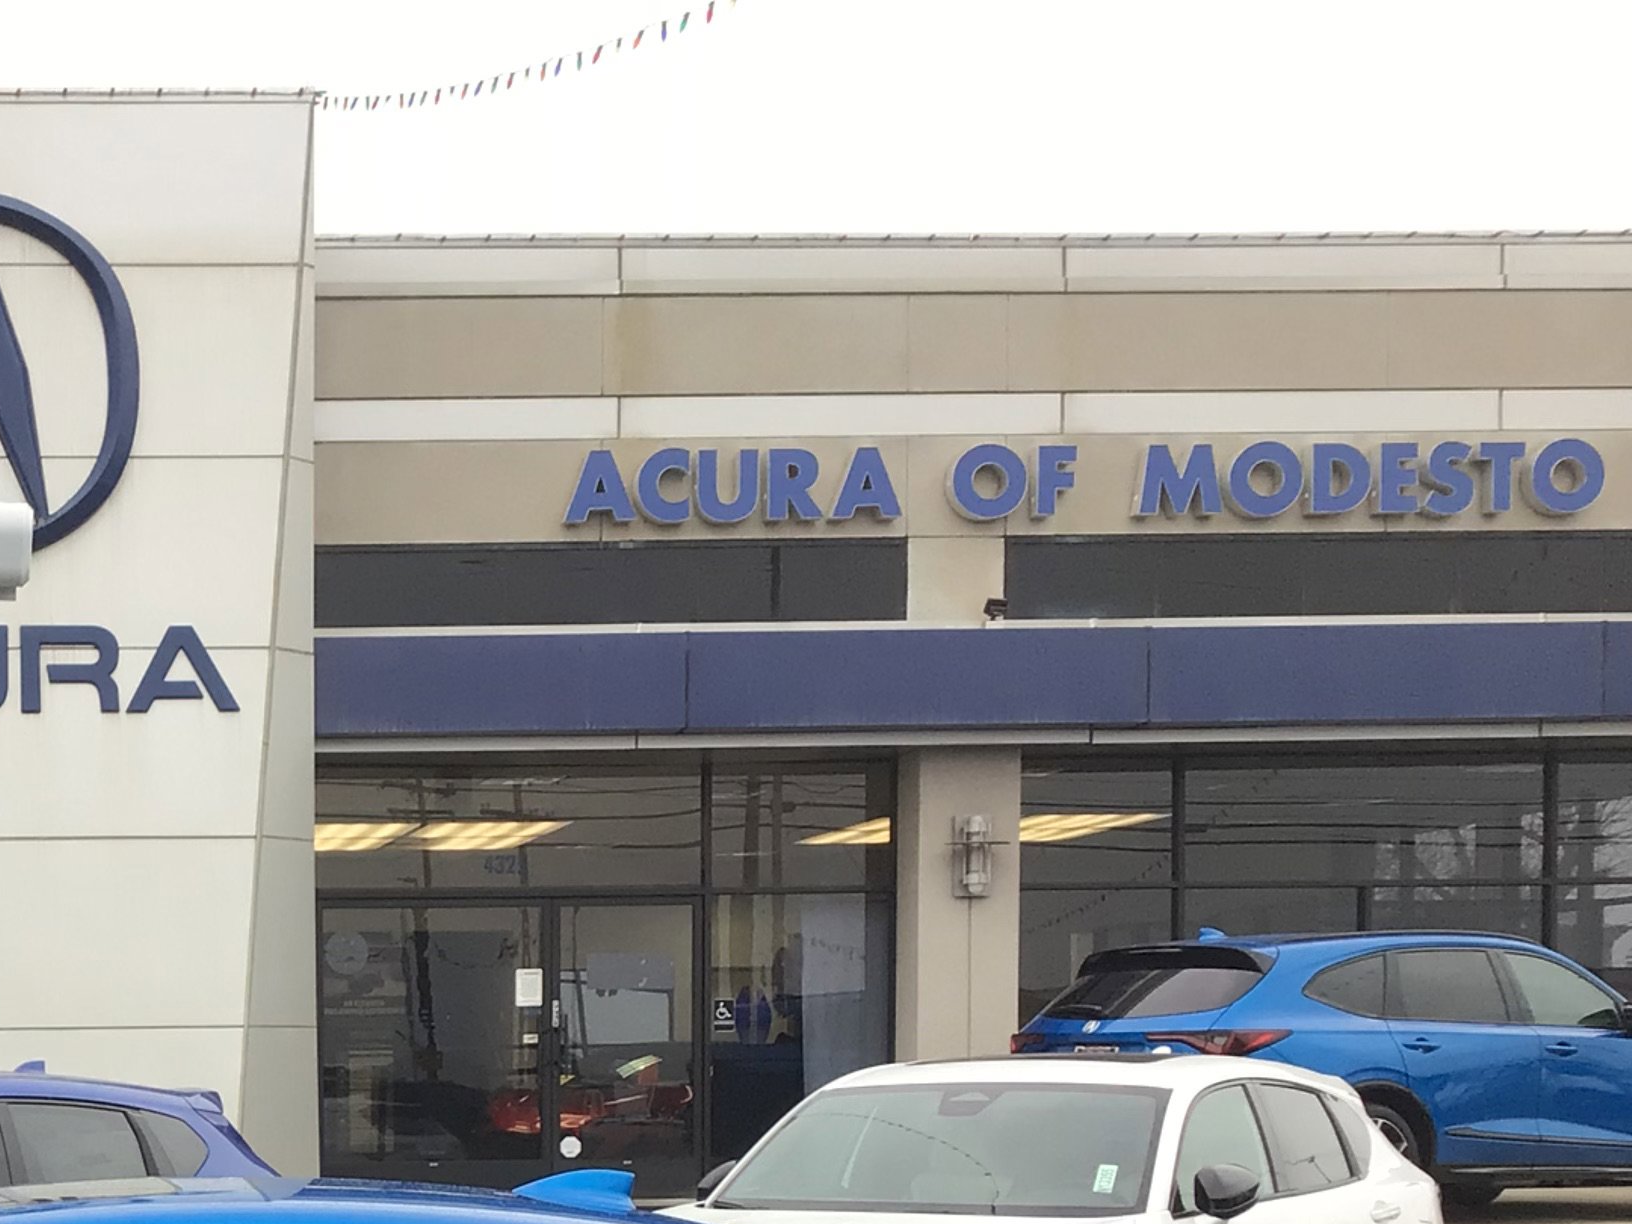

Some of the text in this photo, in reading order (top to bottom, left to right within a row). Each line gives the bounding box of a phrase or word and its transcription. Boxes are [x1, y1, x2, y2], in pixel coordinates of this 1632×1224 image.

[562, 436, 1608, 526] ACURA OF MODESTO
[483, 854, 528, 876] 432
